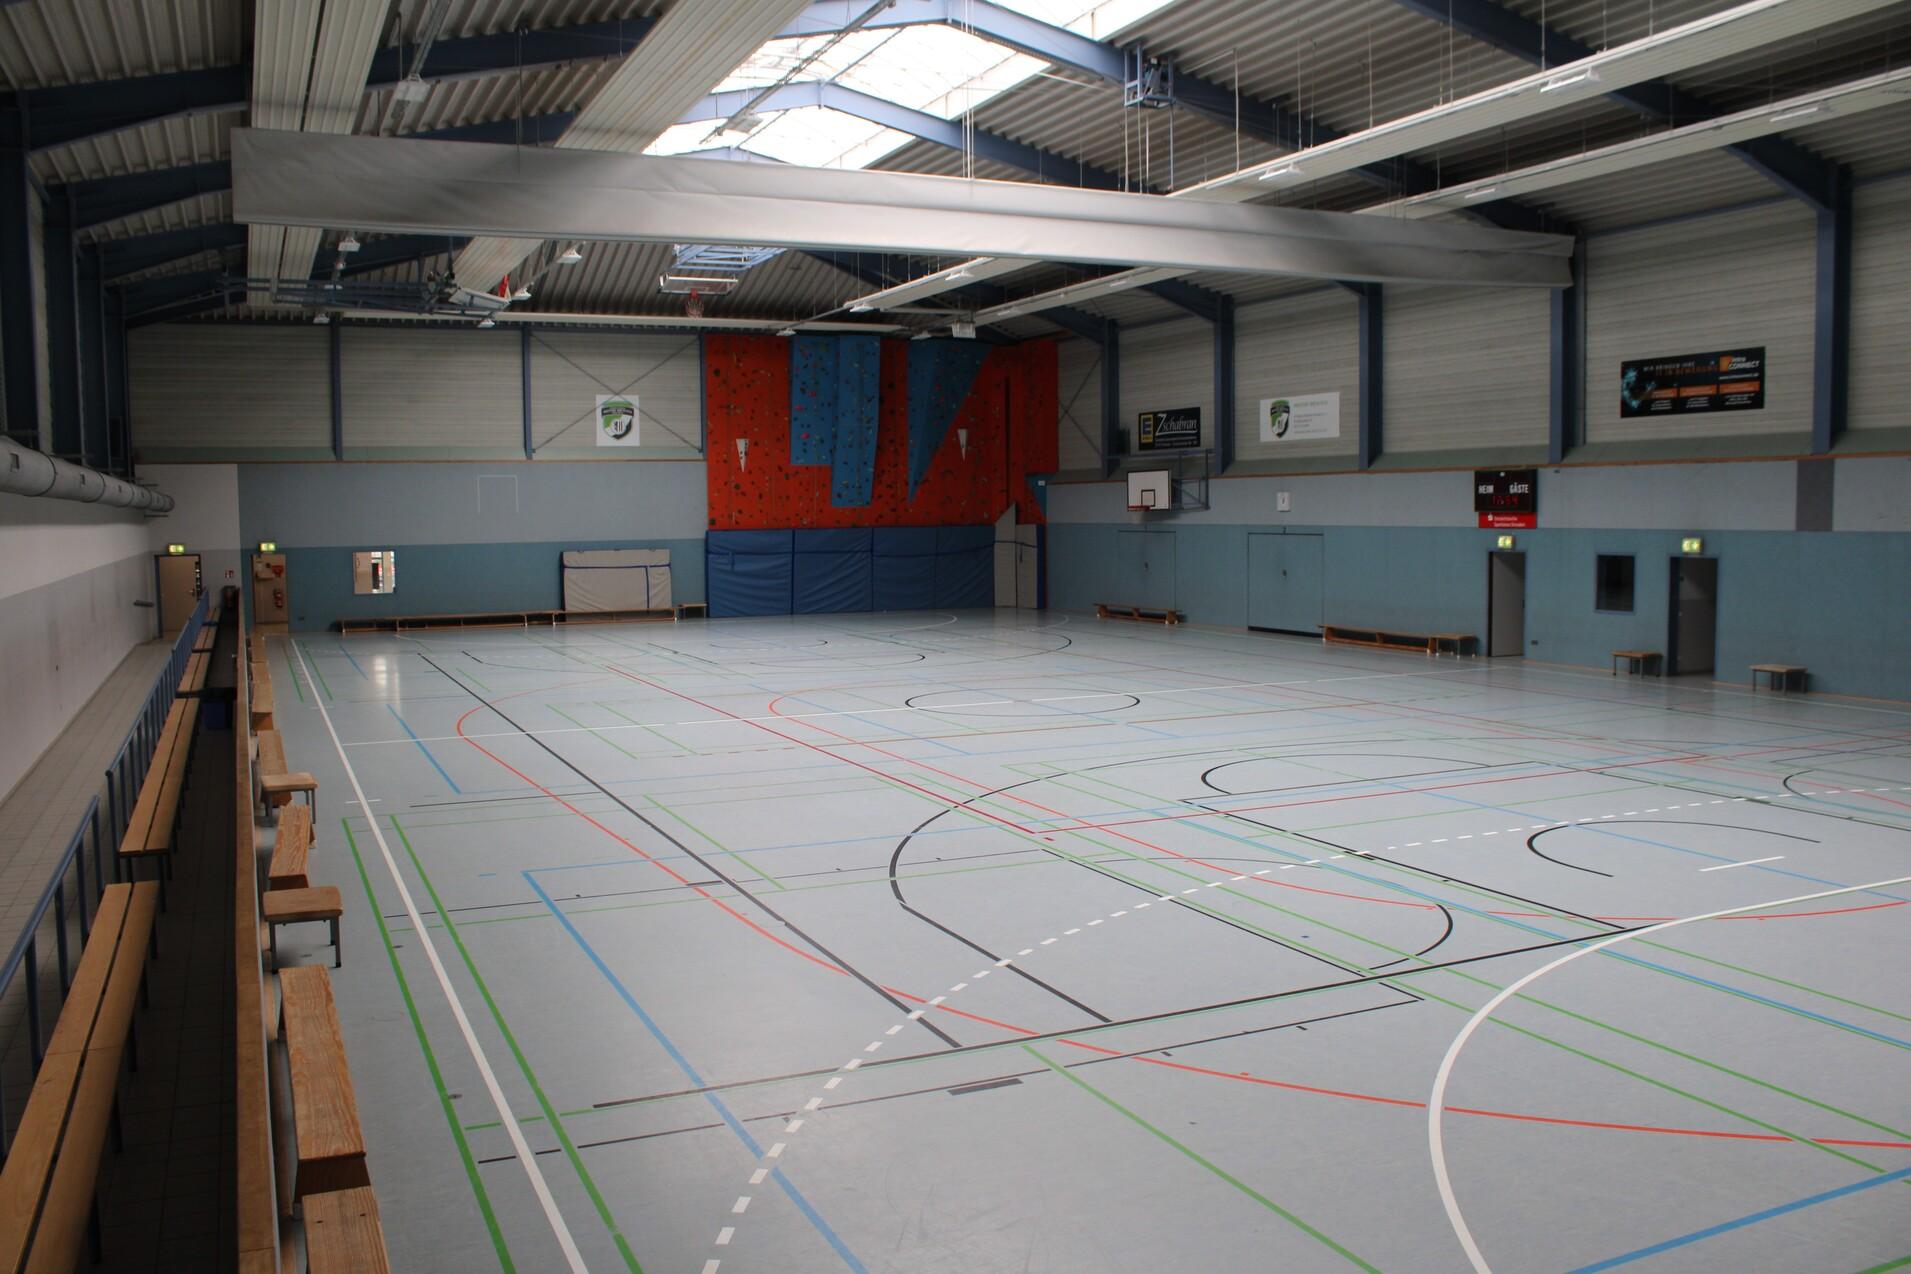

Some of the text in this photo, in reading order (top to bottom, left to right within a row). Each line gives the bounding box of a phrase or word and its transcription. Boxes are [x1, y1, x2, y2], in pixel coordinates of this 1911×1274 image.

[1728, 360, 1760, 370] CONNECT
[1478, 482, 1529, 494] HEIM GÄSTE
